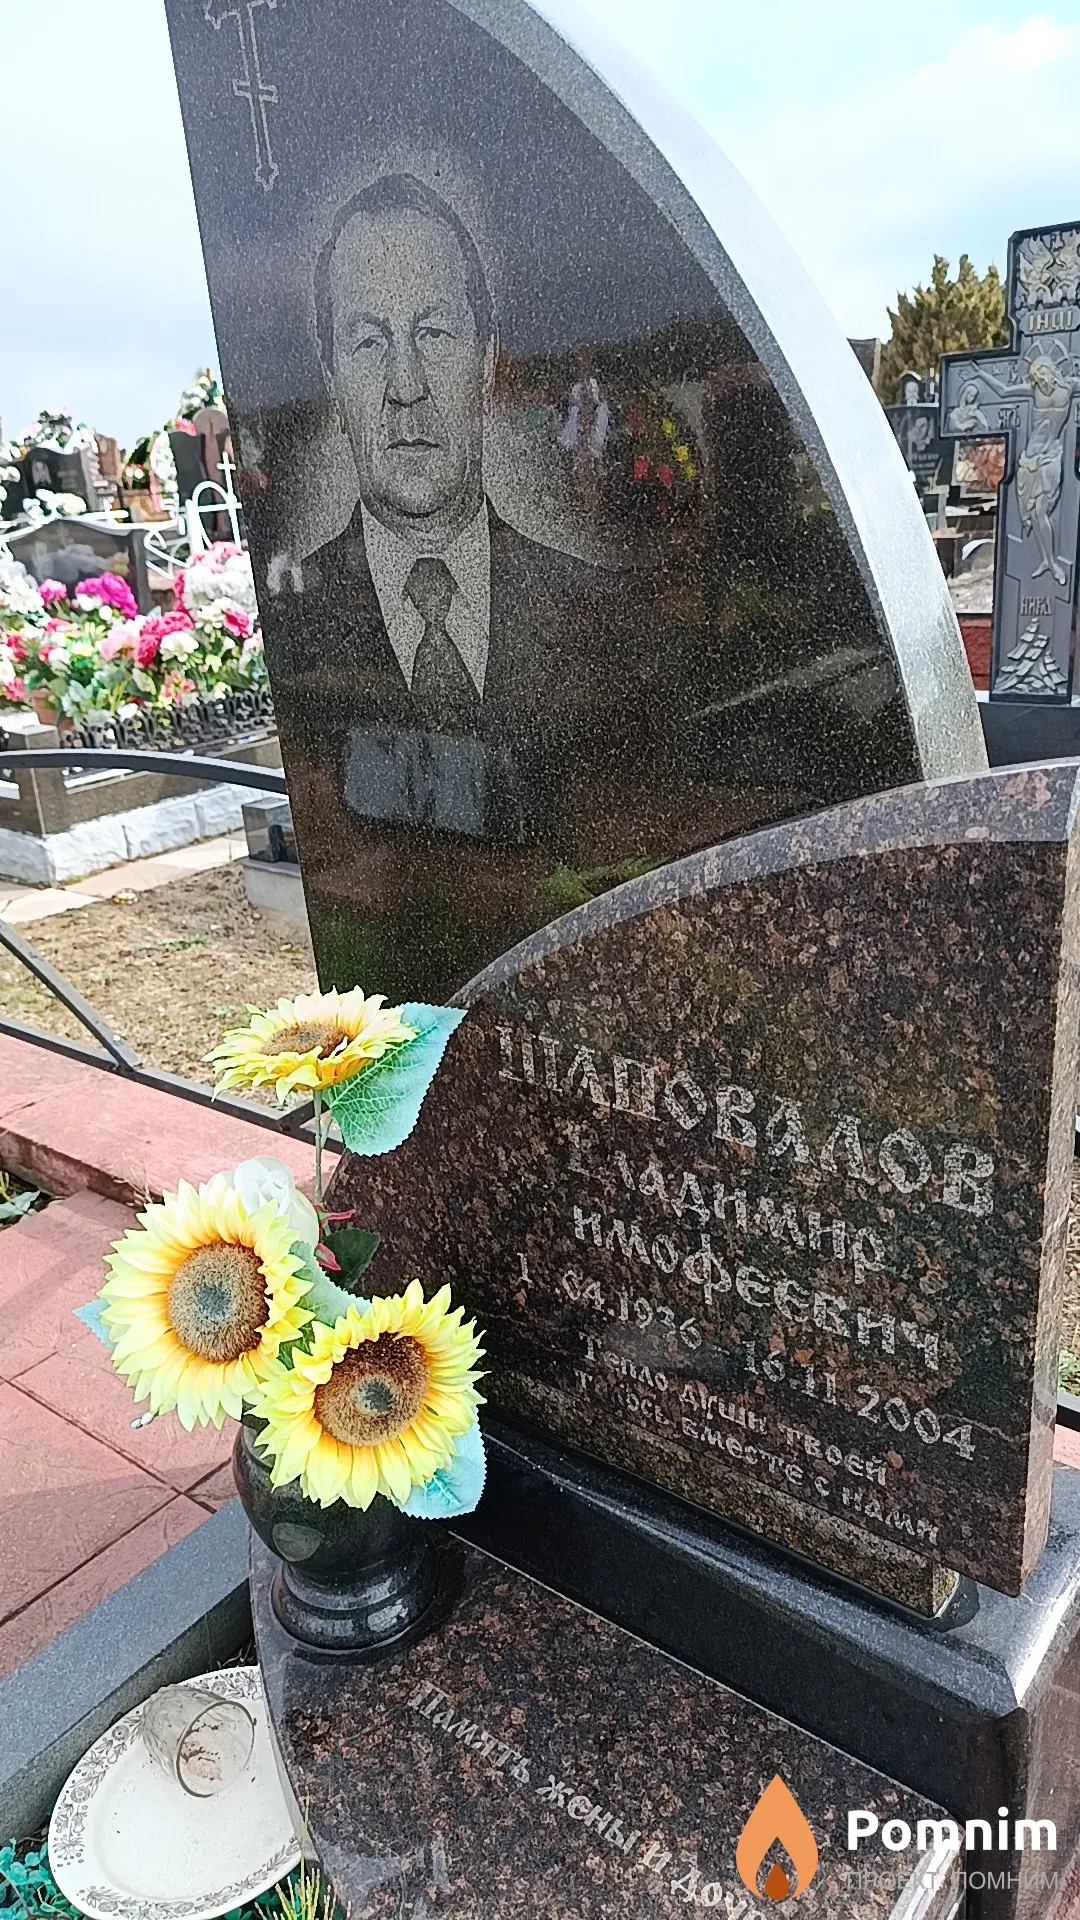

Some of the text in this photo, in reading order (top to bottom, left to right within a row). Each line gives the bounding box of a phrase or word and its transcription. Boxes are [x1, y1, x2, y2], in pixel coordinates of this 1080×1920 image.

[495, 1026, 995, 1218] ШАПОВАЛОВ
[572, 1205, 940, 1371] имофеевич
[578, 1331, 670, 1393] Тепло
[777, 1421, 887, 1487] твоей
[842, 1486, 940, 1546] нами
[406, 1680, 531, 1784] Память
[534, 1775, 642, 1855] жены
